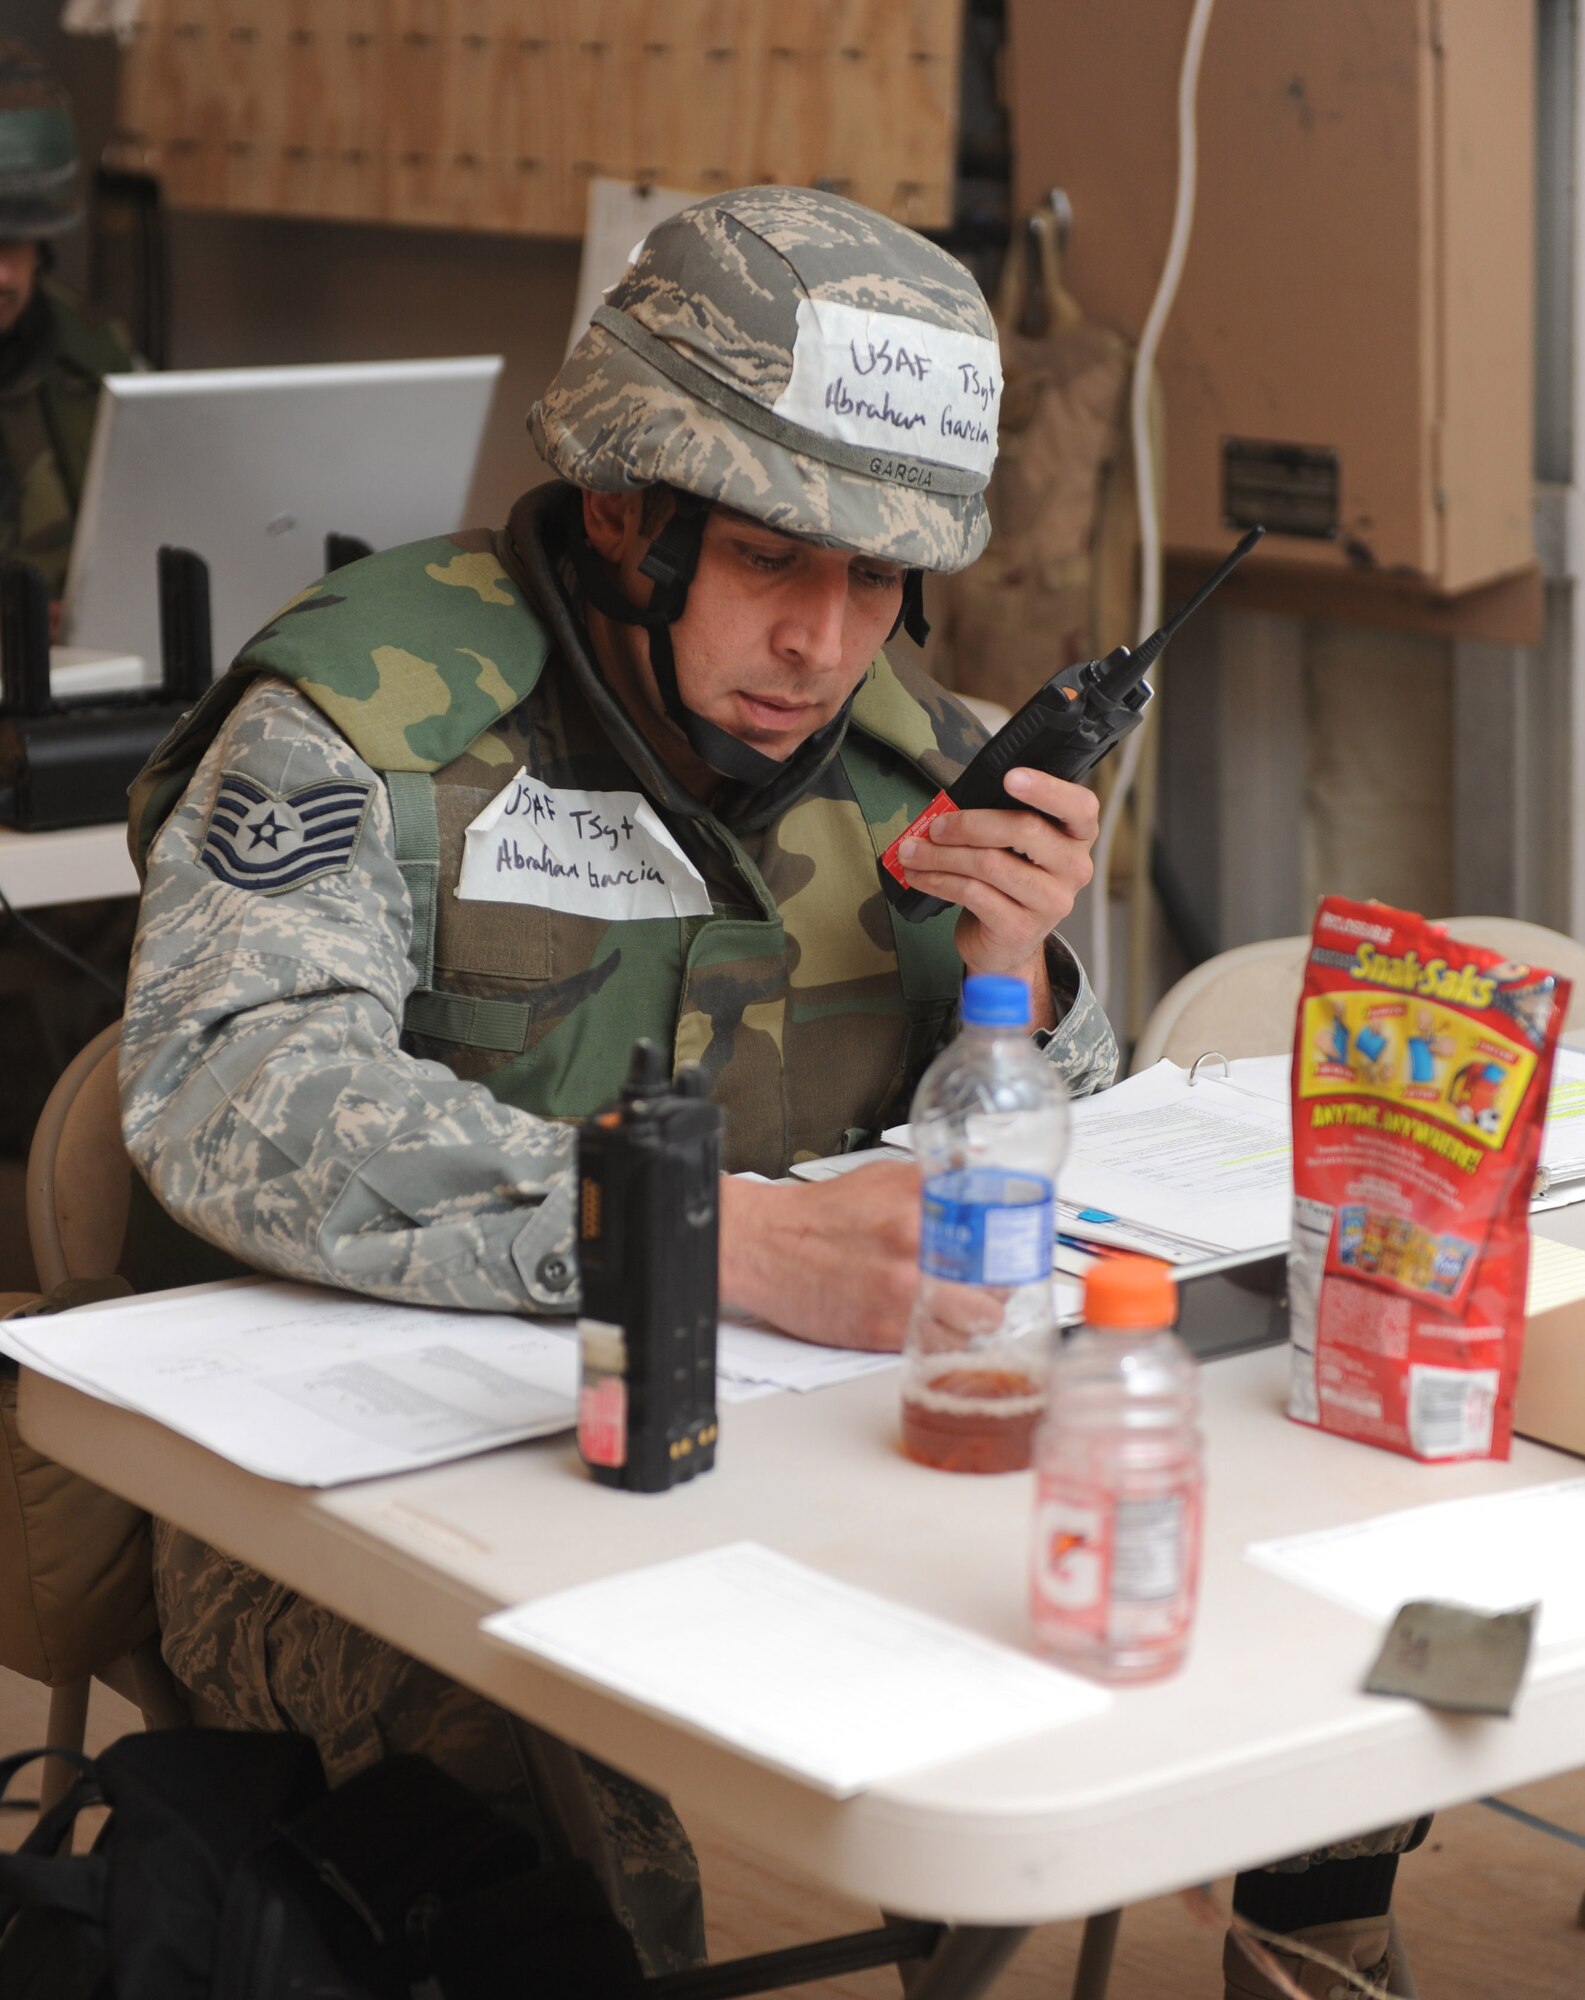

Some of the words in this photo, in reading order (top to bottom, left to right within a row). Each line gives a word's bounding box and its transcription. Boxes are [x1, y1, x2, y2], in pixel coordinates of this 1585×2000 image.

[850, 338, 932, 381] USAF
[958, 363, 995, 411] TSgt
[825, 377, 926, 430] Abraham
[940, 405, 989, 445] Garcia
[869, 457, 933, 487] GARCIA
[569, 810, 634, 850] TSgt
[496, 838, 579, 879] Abraham
[587, 861, 665, 888] Garcia
